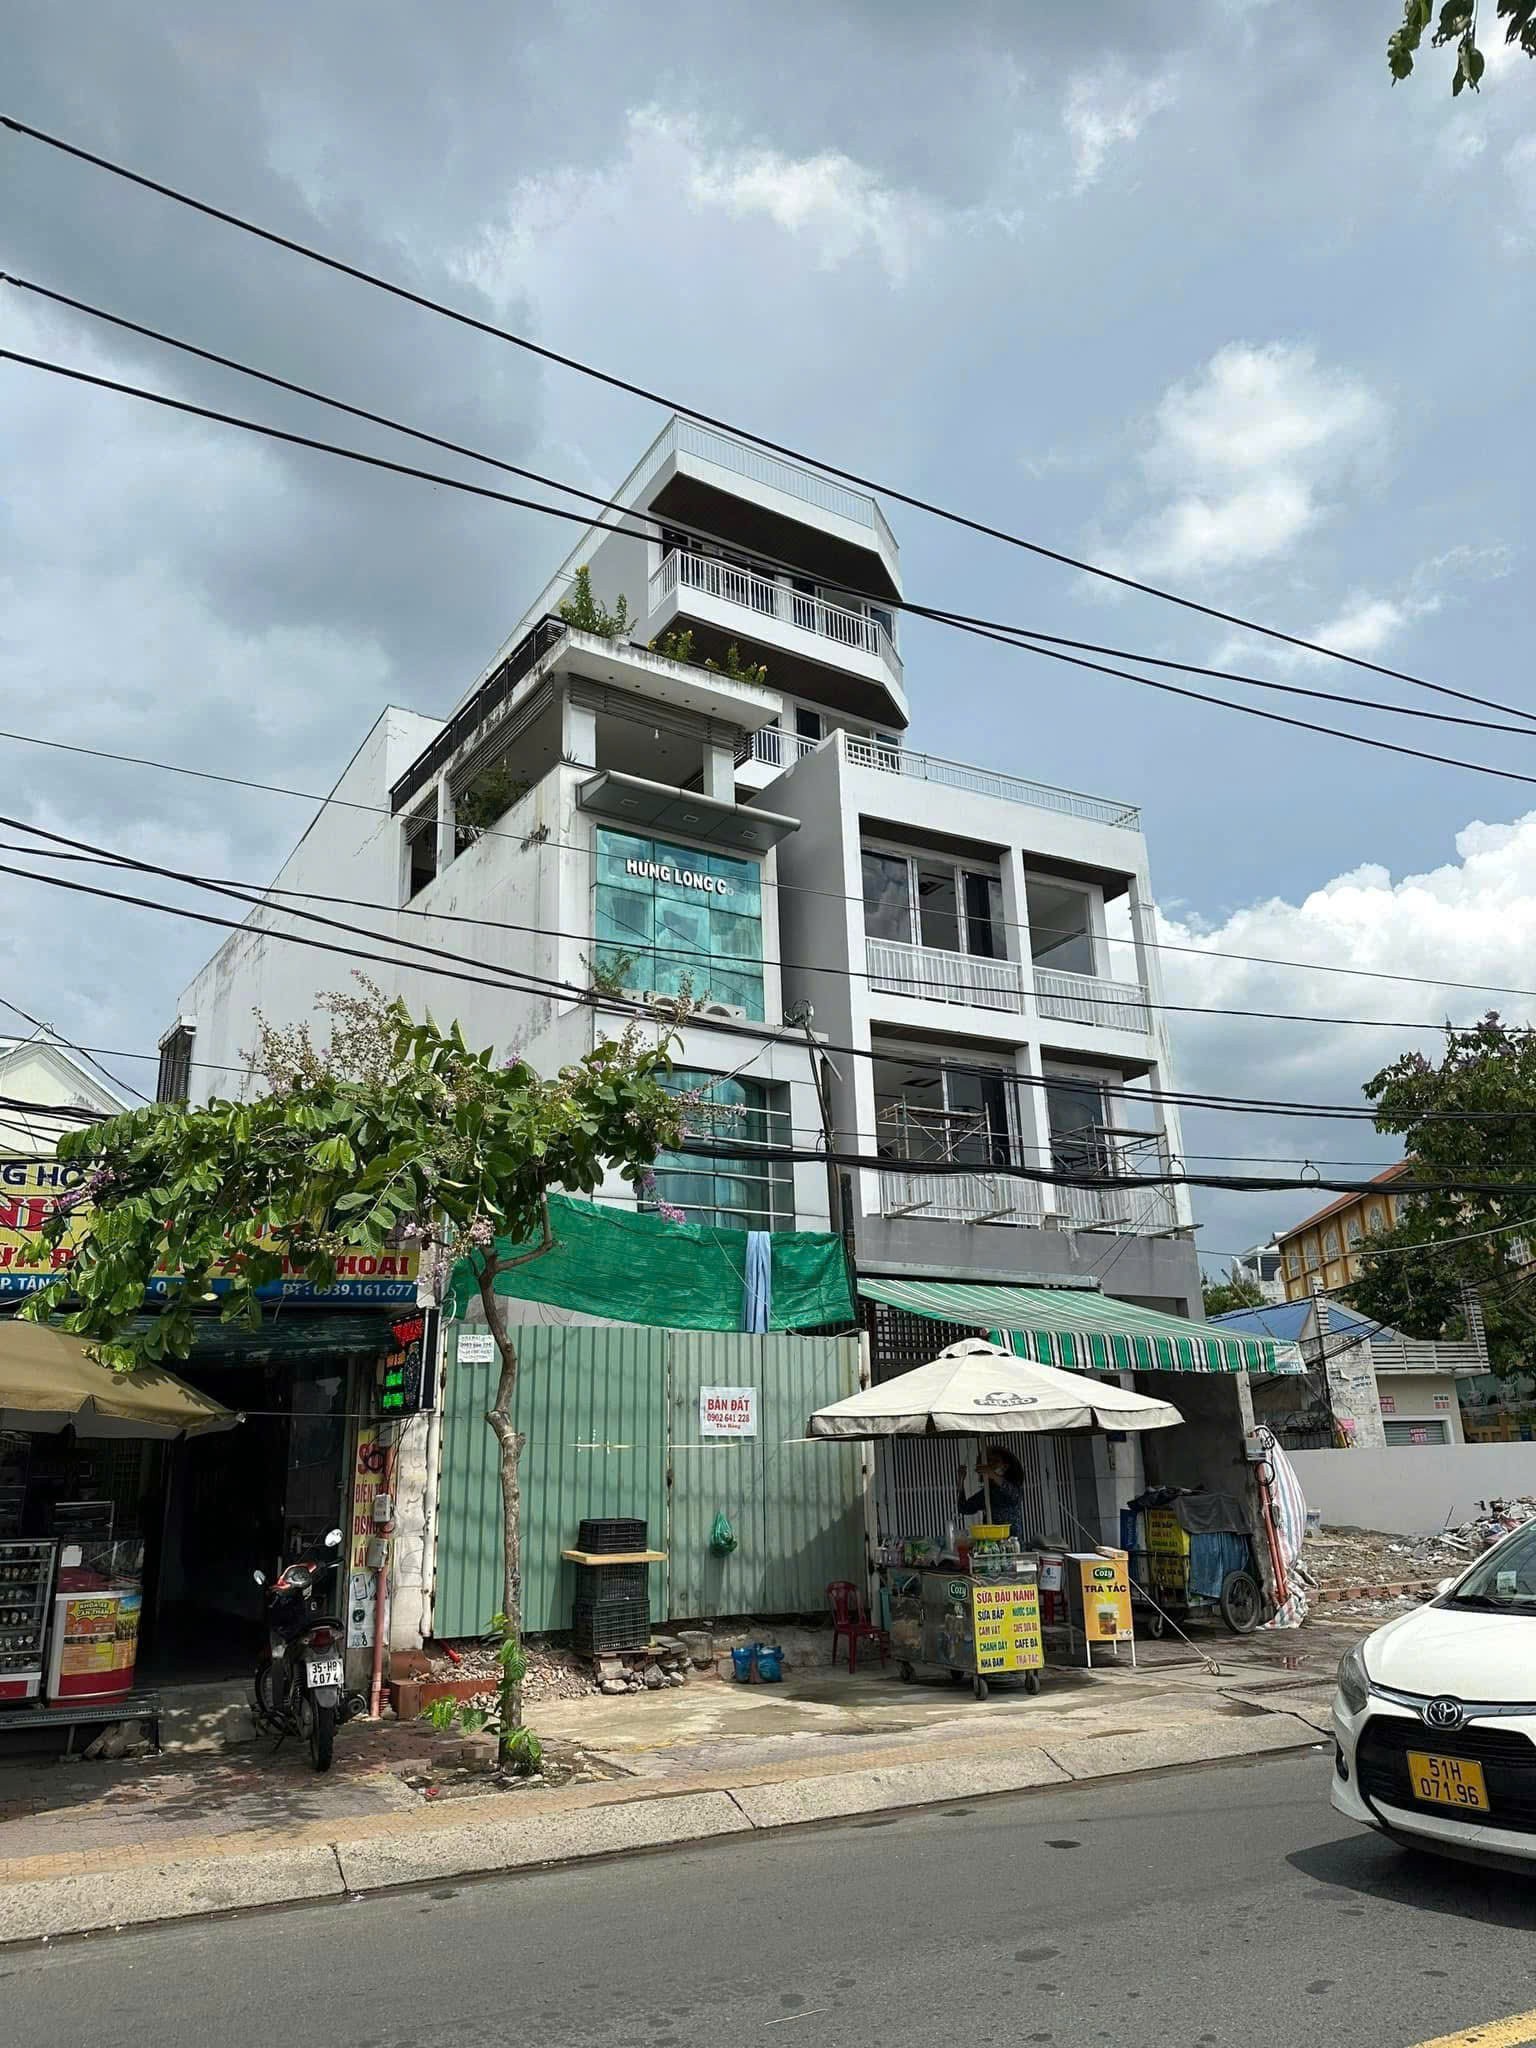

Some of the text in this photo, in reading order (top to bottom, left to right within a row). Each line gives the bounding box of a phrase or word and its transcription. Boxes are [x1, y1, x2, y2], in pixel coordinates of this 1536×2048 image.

[674, 868, 713, 893] LONG
[707, 1395, 750, 1411] BÁN ĐẤT
[724, 1413, 737, 1423] 641
[1094, 1567, 1114, 1579] Cozy
[950, 1584, 967, 1597] Cozy
[1084, 1583, 1105, 1593] TRÀ
[1015, 1638, 1029, 1649] CAFE
[1429, 1758, 1462, 1782] 51H
[1420, 1777, 1479, 1806] 071.96
